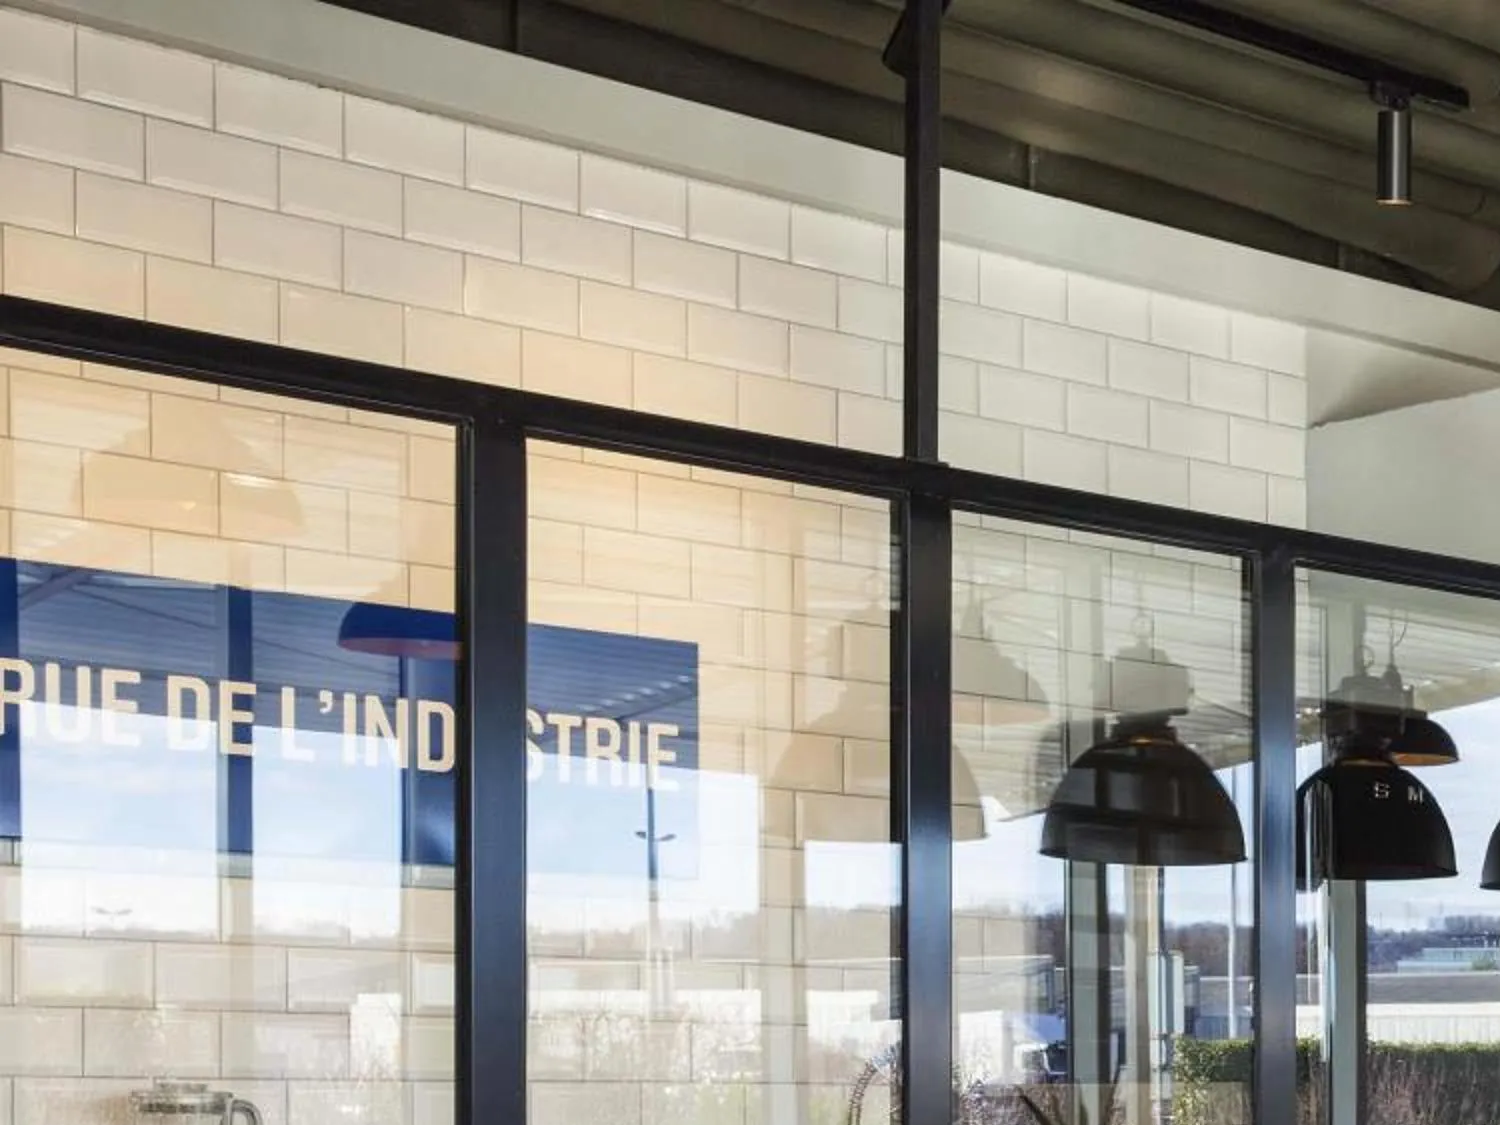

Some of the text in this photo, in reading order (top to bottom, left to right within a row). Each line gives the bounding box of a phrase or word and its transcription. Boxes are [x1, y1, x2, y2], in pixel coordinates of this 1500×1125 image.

[0, 657, 679, 791] RUE DE L’INDSTRIE
